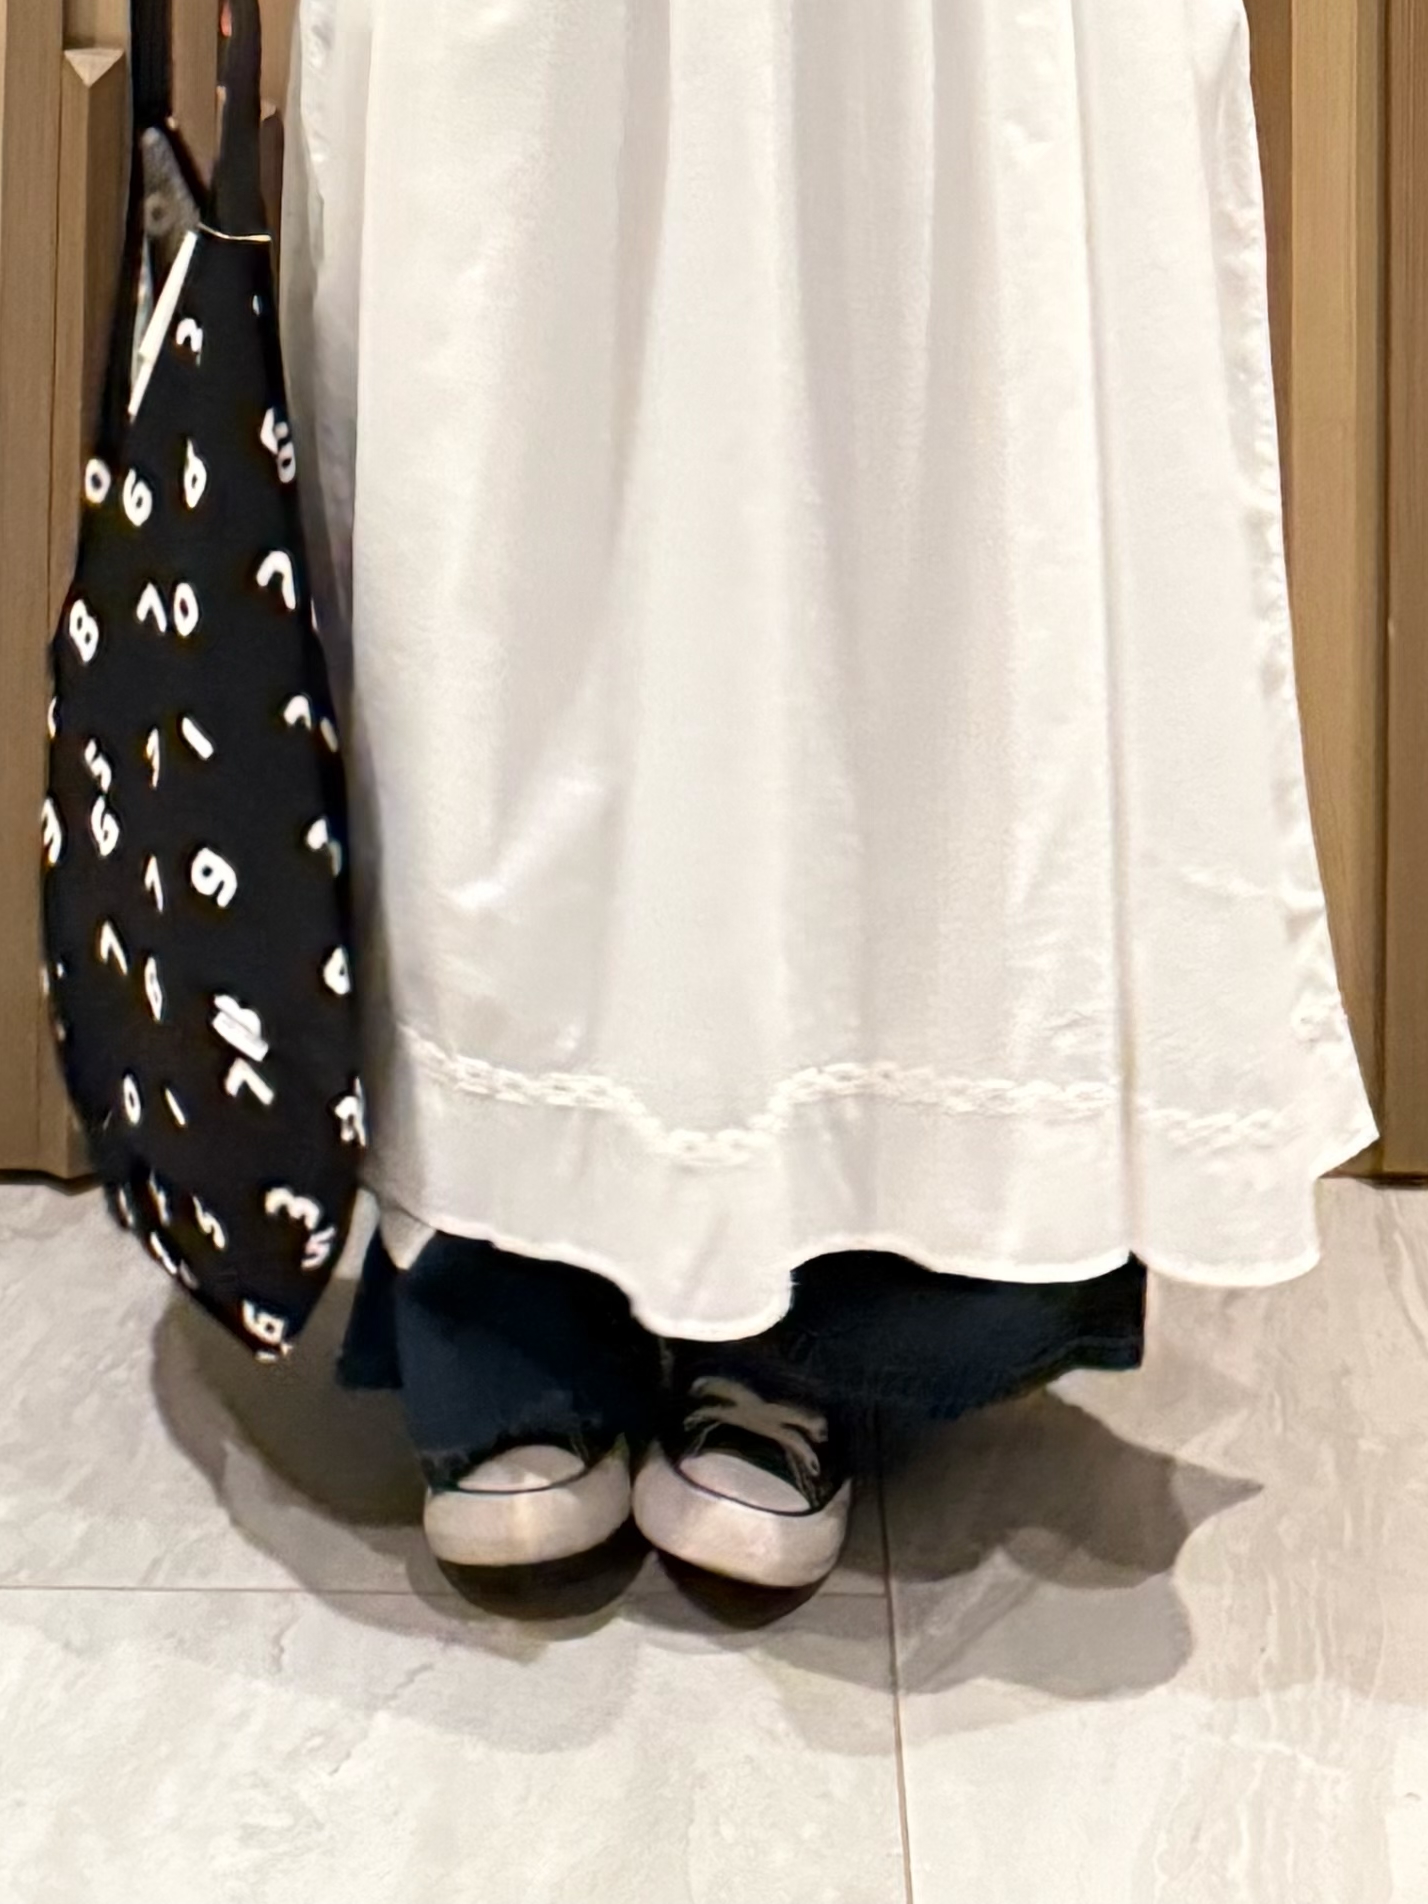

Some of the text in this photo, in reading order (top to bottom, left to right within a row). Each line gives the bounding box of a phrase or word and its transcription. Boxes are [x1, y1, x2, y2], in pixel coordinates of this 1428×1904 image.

[120, 467, 154, 527] 6
[68, 598, 101, 665] 8
[190, 846, 239, 909] 9
